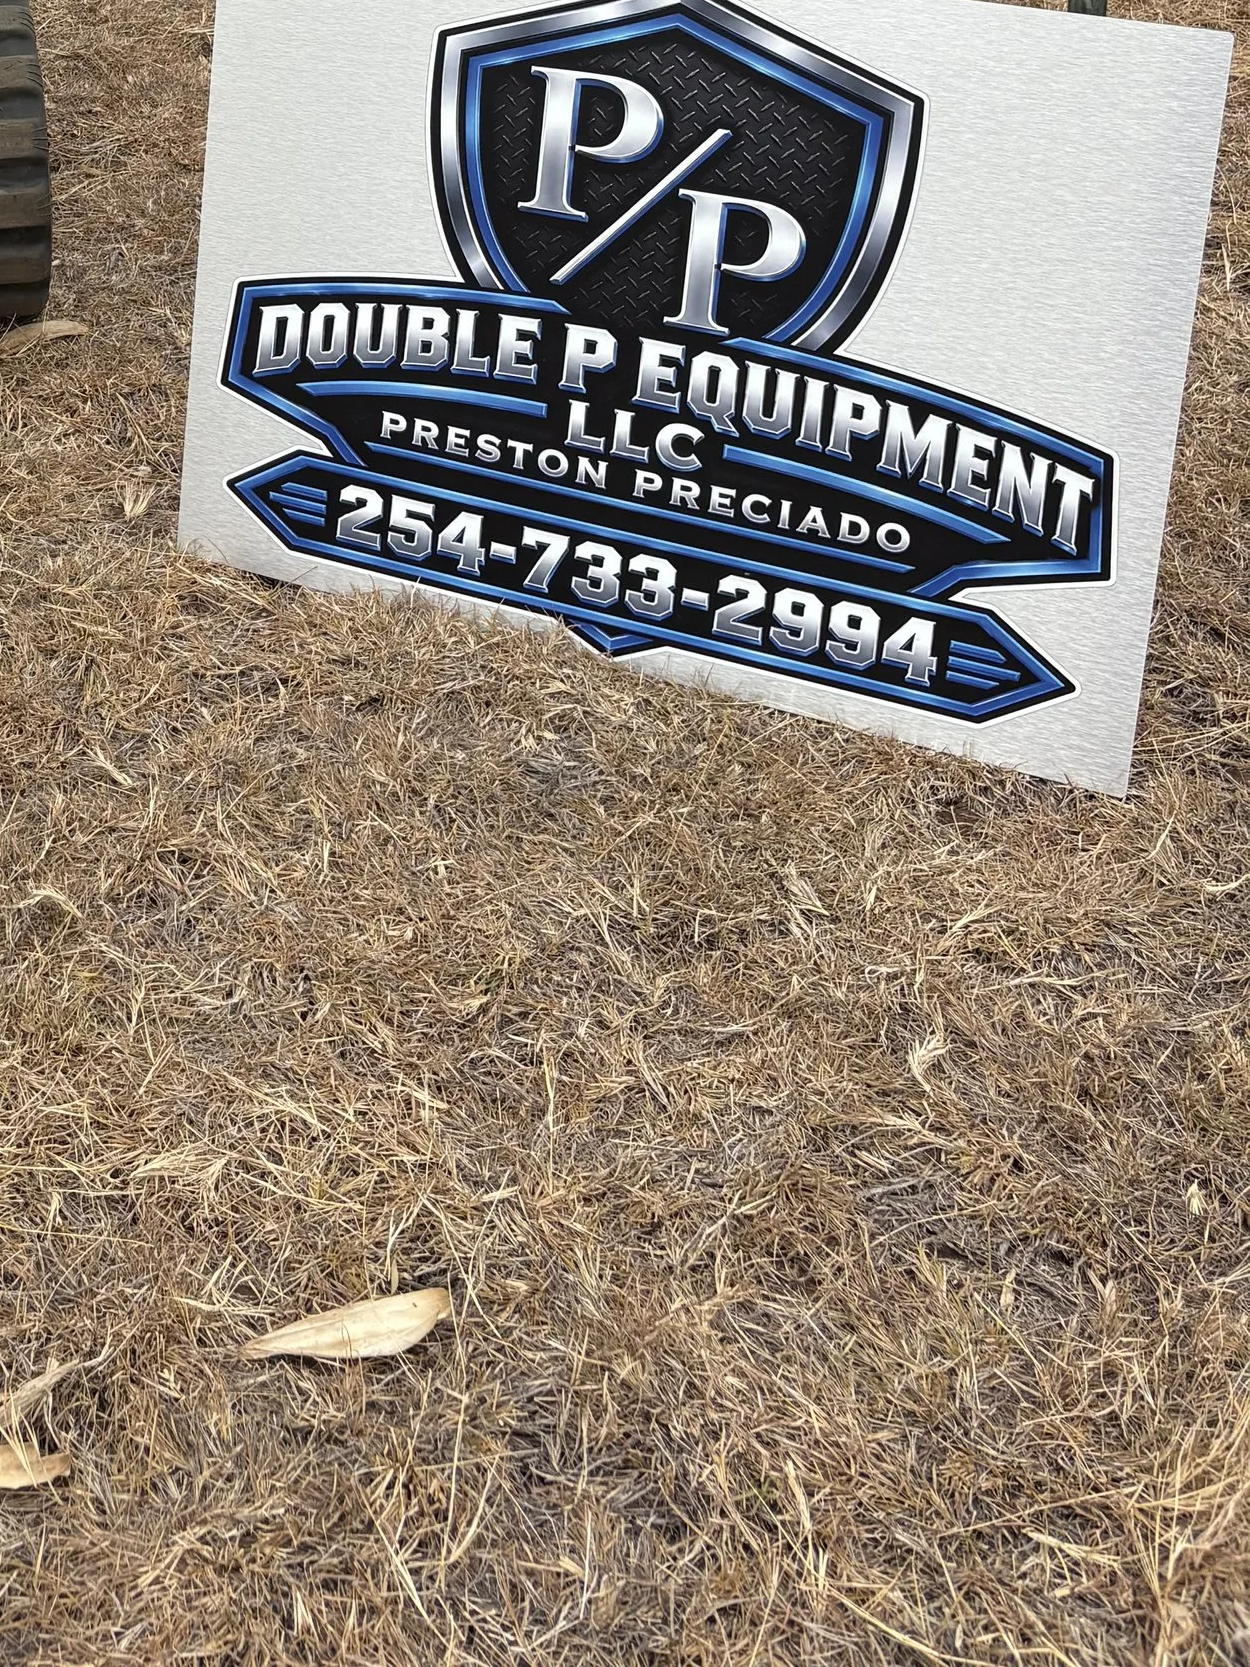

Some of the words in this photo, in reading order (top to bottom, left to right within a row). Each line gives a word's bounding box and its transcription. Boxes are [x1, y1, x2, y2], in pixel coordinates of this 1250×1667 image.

[252, 302, 543, 385] DOUBLE
[558, 321, 619, 394] P
[631, 336, 1095, 555] EQUIPMENT
[380, 410, 610, 491] PRESTON
[632, 468, 912, 553] PRECIADO
[564, 398, 705, 473] LLC
[335, 484, 938, 687] 254-733-2994
